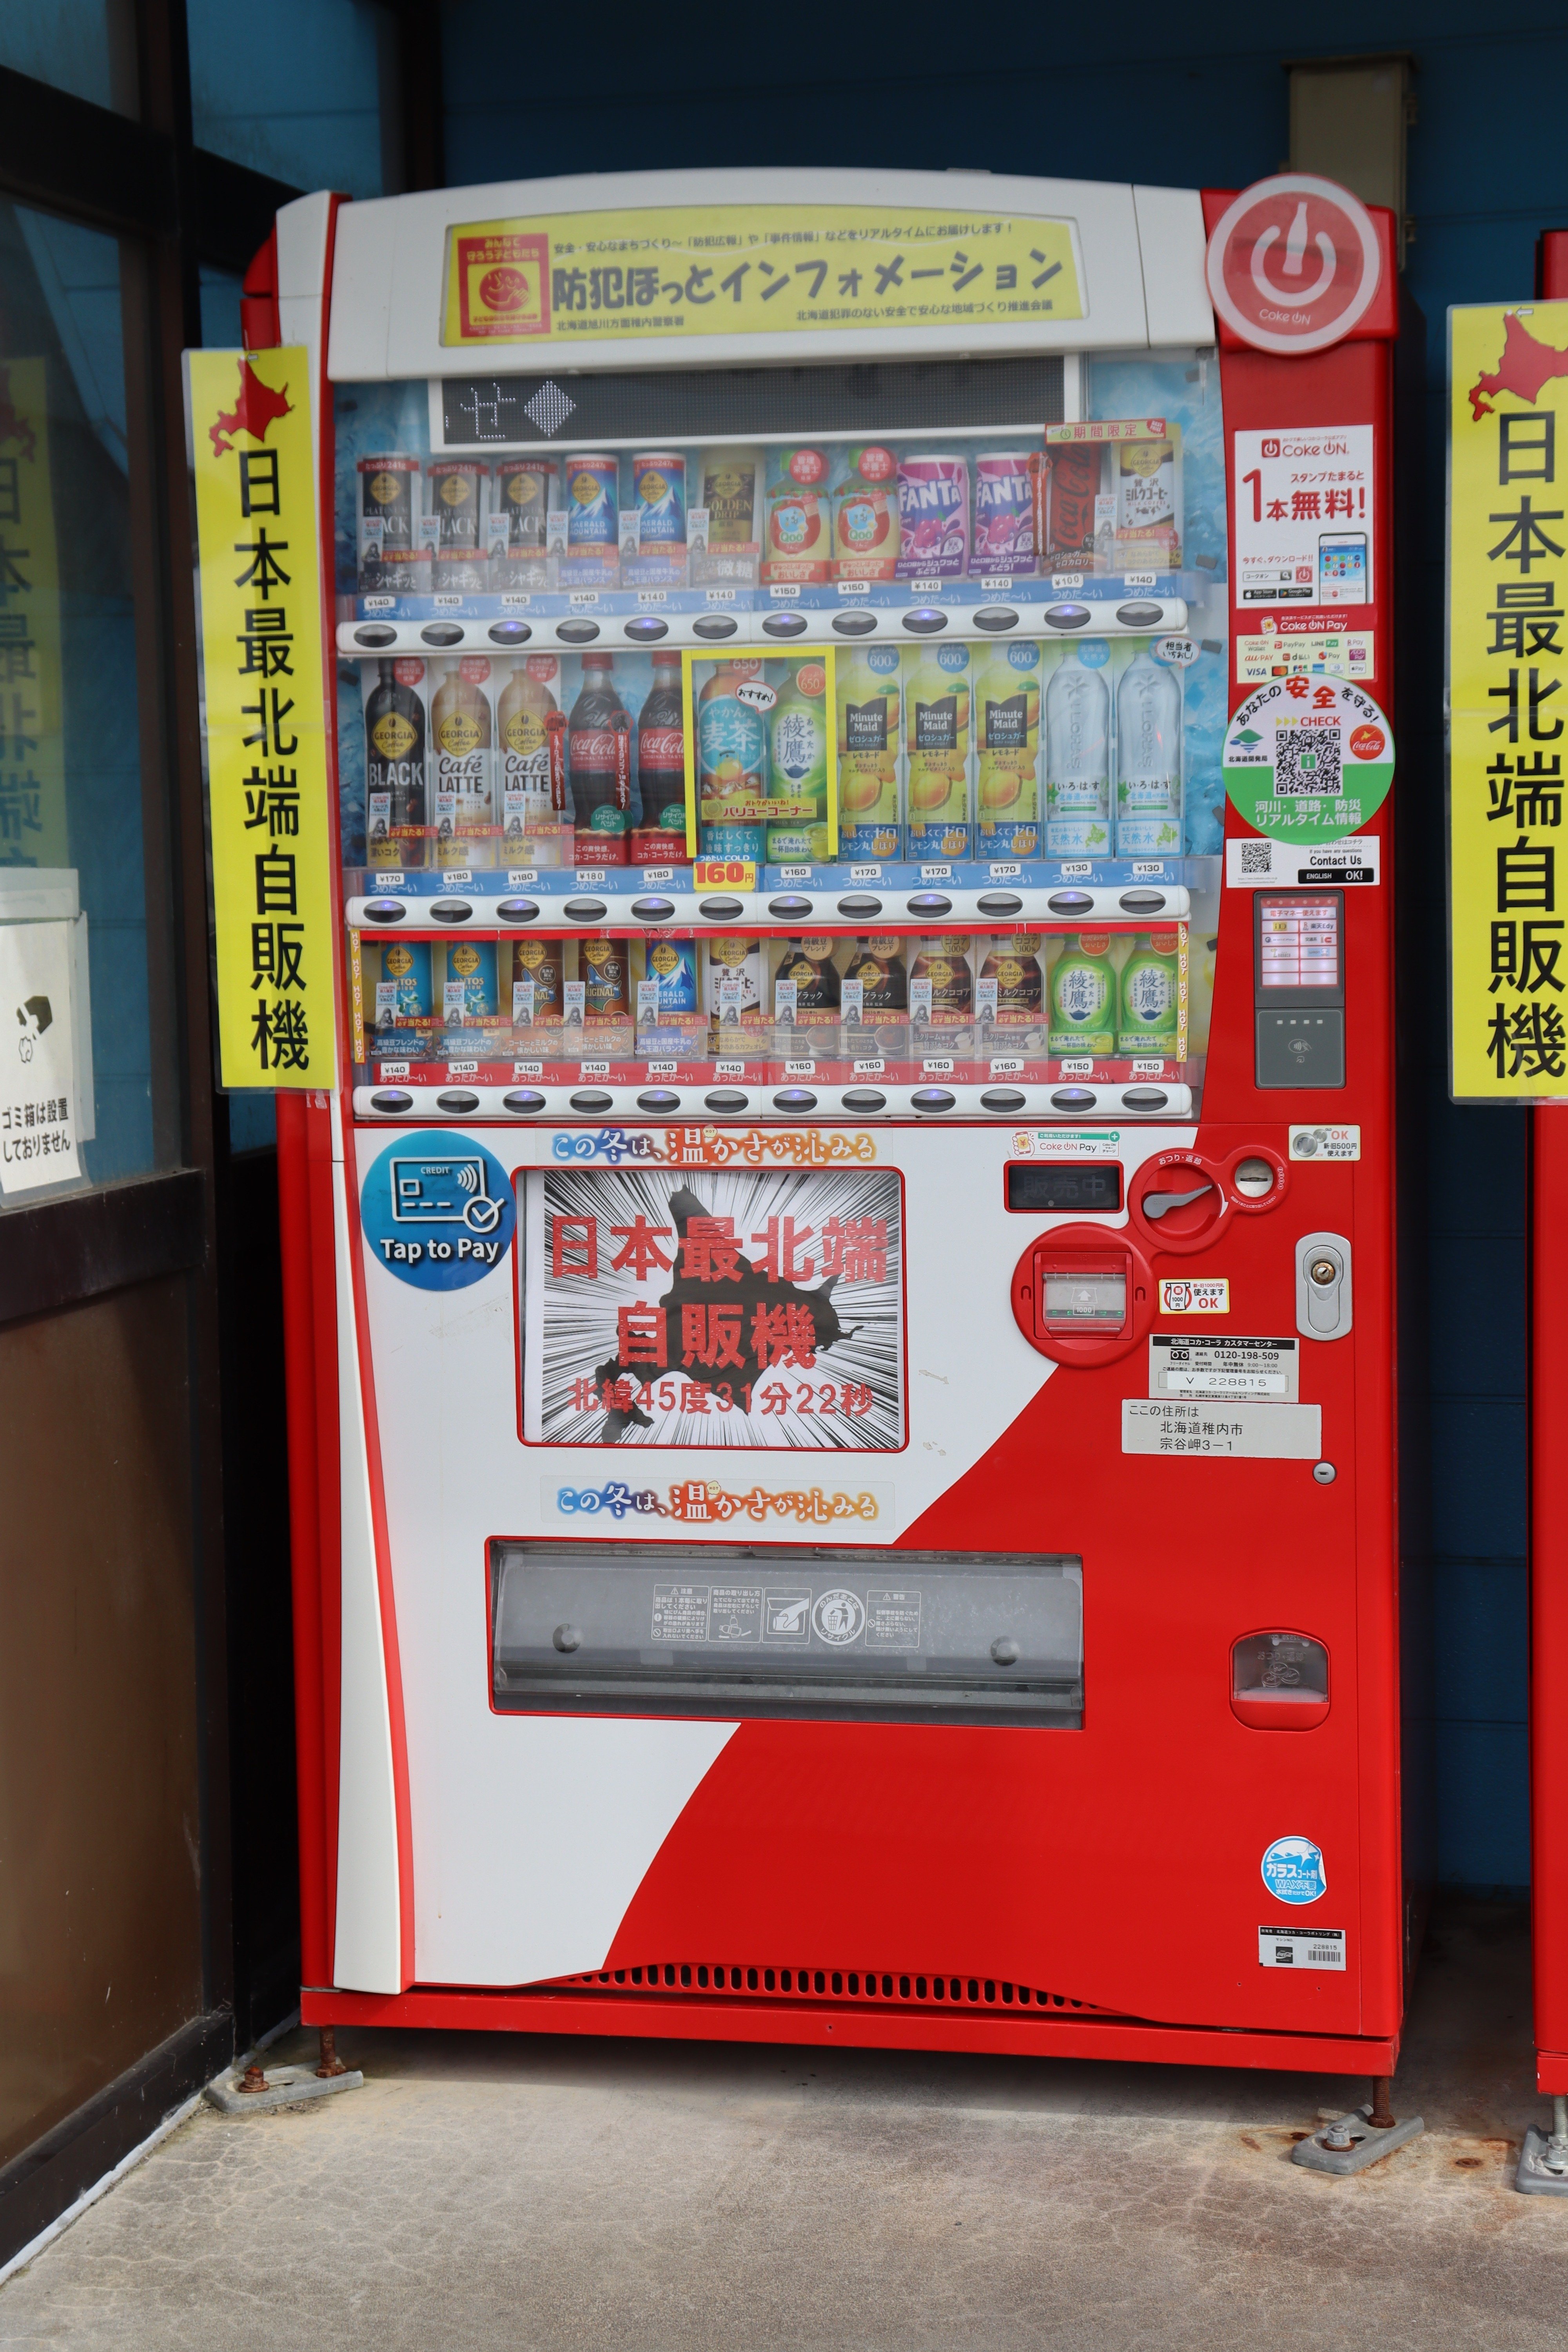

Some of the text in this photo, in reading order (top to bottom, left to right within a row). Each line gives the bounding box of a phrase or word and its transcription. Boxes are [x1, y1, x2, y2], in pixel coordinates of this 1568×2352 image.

[552, 247, 1063, 312] 防犯ほっとインフォメーション
[1259, 309, 1289, 322] Coke
[1073, 424, 1137, 439] 期間限定
[1283, 440, 1347, 457] Coke ON
[1291, 470, 1365, 483] スタンプたまると
[899, 479, 962, 512] FANTA
[780, 533, 803, 542] Qoo
[849, 530, 873, 540] Qoo
[915, 582, 938, 590] ¥140
[985, 579, 1009, 588] ¥140
[1055, 575, 1079, 586] ¥100
[842, 583, 864, 591] ¥150
[641, 592, 664, 601] ¥140
[709, 591, 733, 599] ¥140
[368, 598, 389, 607] ¥140
[1280, 619, 1348, 631] Coke ON Pay
[1166, 642, 1192, 651] 担当者
[1247, 668, 1267, 676] VISA
[850, 713, 883, 723] Minute
[920, 711, 953, 721] Minute
[989, 710, 1022, 720] Minute
[1301, 716, 1341, 726] CHECK
[854, 723, 878, 731] Maid
[924, 721, 948, 730] Maid
[994, 720, 1018, 728] Maid
[374, 731, 413, 740] GEORGIA
[506, 728, 546, 737] GEORGIA
[703, 719, 760, 753] 麦茶
[783, 714, 807, 764] 綾鷹
[806, 718, 815, 760] あやたか
[1485, 411, 1567, 1080] 日本最北端自販機
[232, 448, 310, 1071] 日本最北端自販機
[439, 755, 483, 774] Café
[505, 753, 548, 773] Café
[368, 762, 424, 786] BLACK
[439, 775, 484, 794] LATTE
[504, 773, 549, 792] LATTE
[1335, 799, 1361, 811] 防災
[723, 806, 813, 817] バリューコーナー
[1257, 812, 1361, 827] リアルタイム情報
[1051, 832, 1083, 845] 天然水
[1122, 831, 1155, 844] 天然水
[706, 840, 759, 853] 後味すっきり
[1310, 855, 1362, 865] Contact Us
[447, 872, 468, 880] ¥180
[512, 873, 533, 881] ¥180
[695, 862, 754, 883] 160円
[1345, 870, 1363, 880] OK!
[1069, 970, 1088, 1009] 綾鷹
[1139, 969, 1160, 1008] 綾鷹
[859, 1061, 881, 1069] ¥160
[994, 1062, 1016, 1070] ¥160
[2, 1097, 69, 1129] ゴミ箱は設置
[1331, 1130, 1348, 1140] OK
[4, 1129, 70, 1163] しておりません
[554, 1128, 873, 1163] この冬は、温かさが沁みる
[1080, 1143, 1097, 1153] Pay
[1024, 1175, 1105, 1199] 販売中
[380, 1238, 499, 1263] Tap to Pay
[552, 1214, 888, 1283] 日本最北端
[1199, 1298, 1219, 1308] OK
[617, 1300, 817, 1369] 自販機
[1214, 1351, 1279, 1360] 0120-198-509
[1209, 1378, 1267, 1387] 228815
[567, 1377, 873, 1417] 北緯45度31分22秒
[1129, 1405, 1199, 1417] ここの住所は
[1160, 1421, 1243, 1436] 北海道稚内市
[560, 1484, 875, 1521] この冬は、温かさが沁みる
[820, 1593, 859, 1610] のんだあとは
[821, 1628, 855, 1641] リサイクル
[1267, 1863, 1318, 1879] ガラスコート剤
[1275, 1879, 1316, 1890] WAX不要
